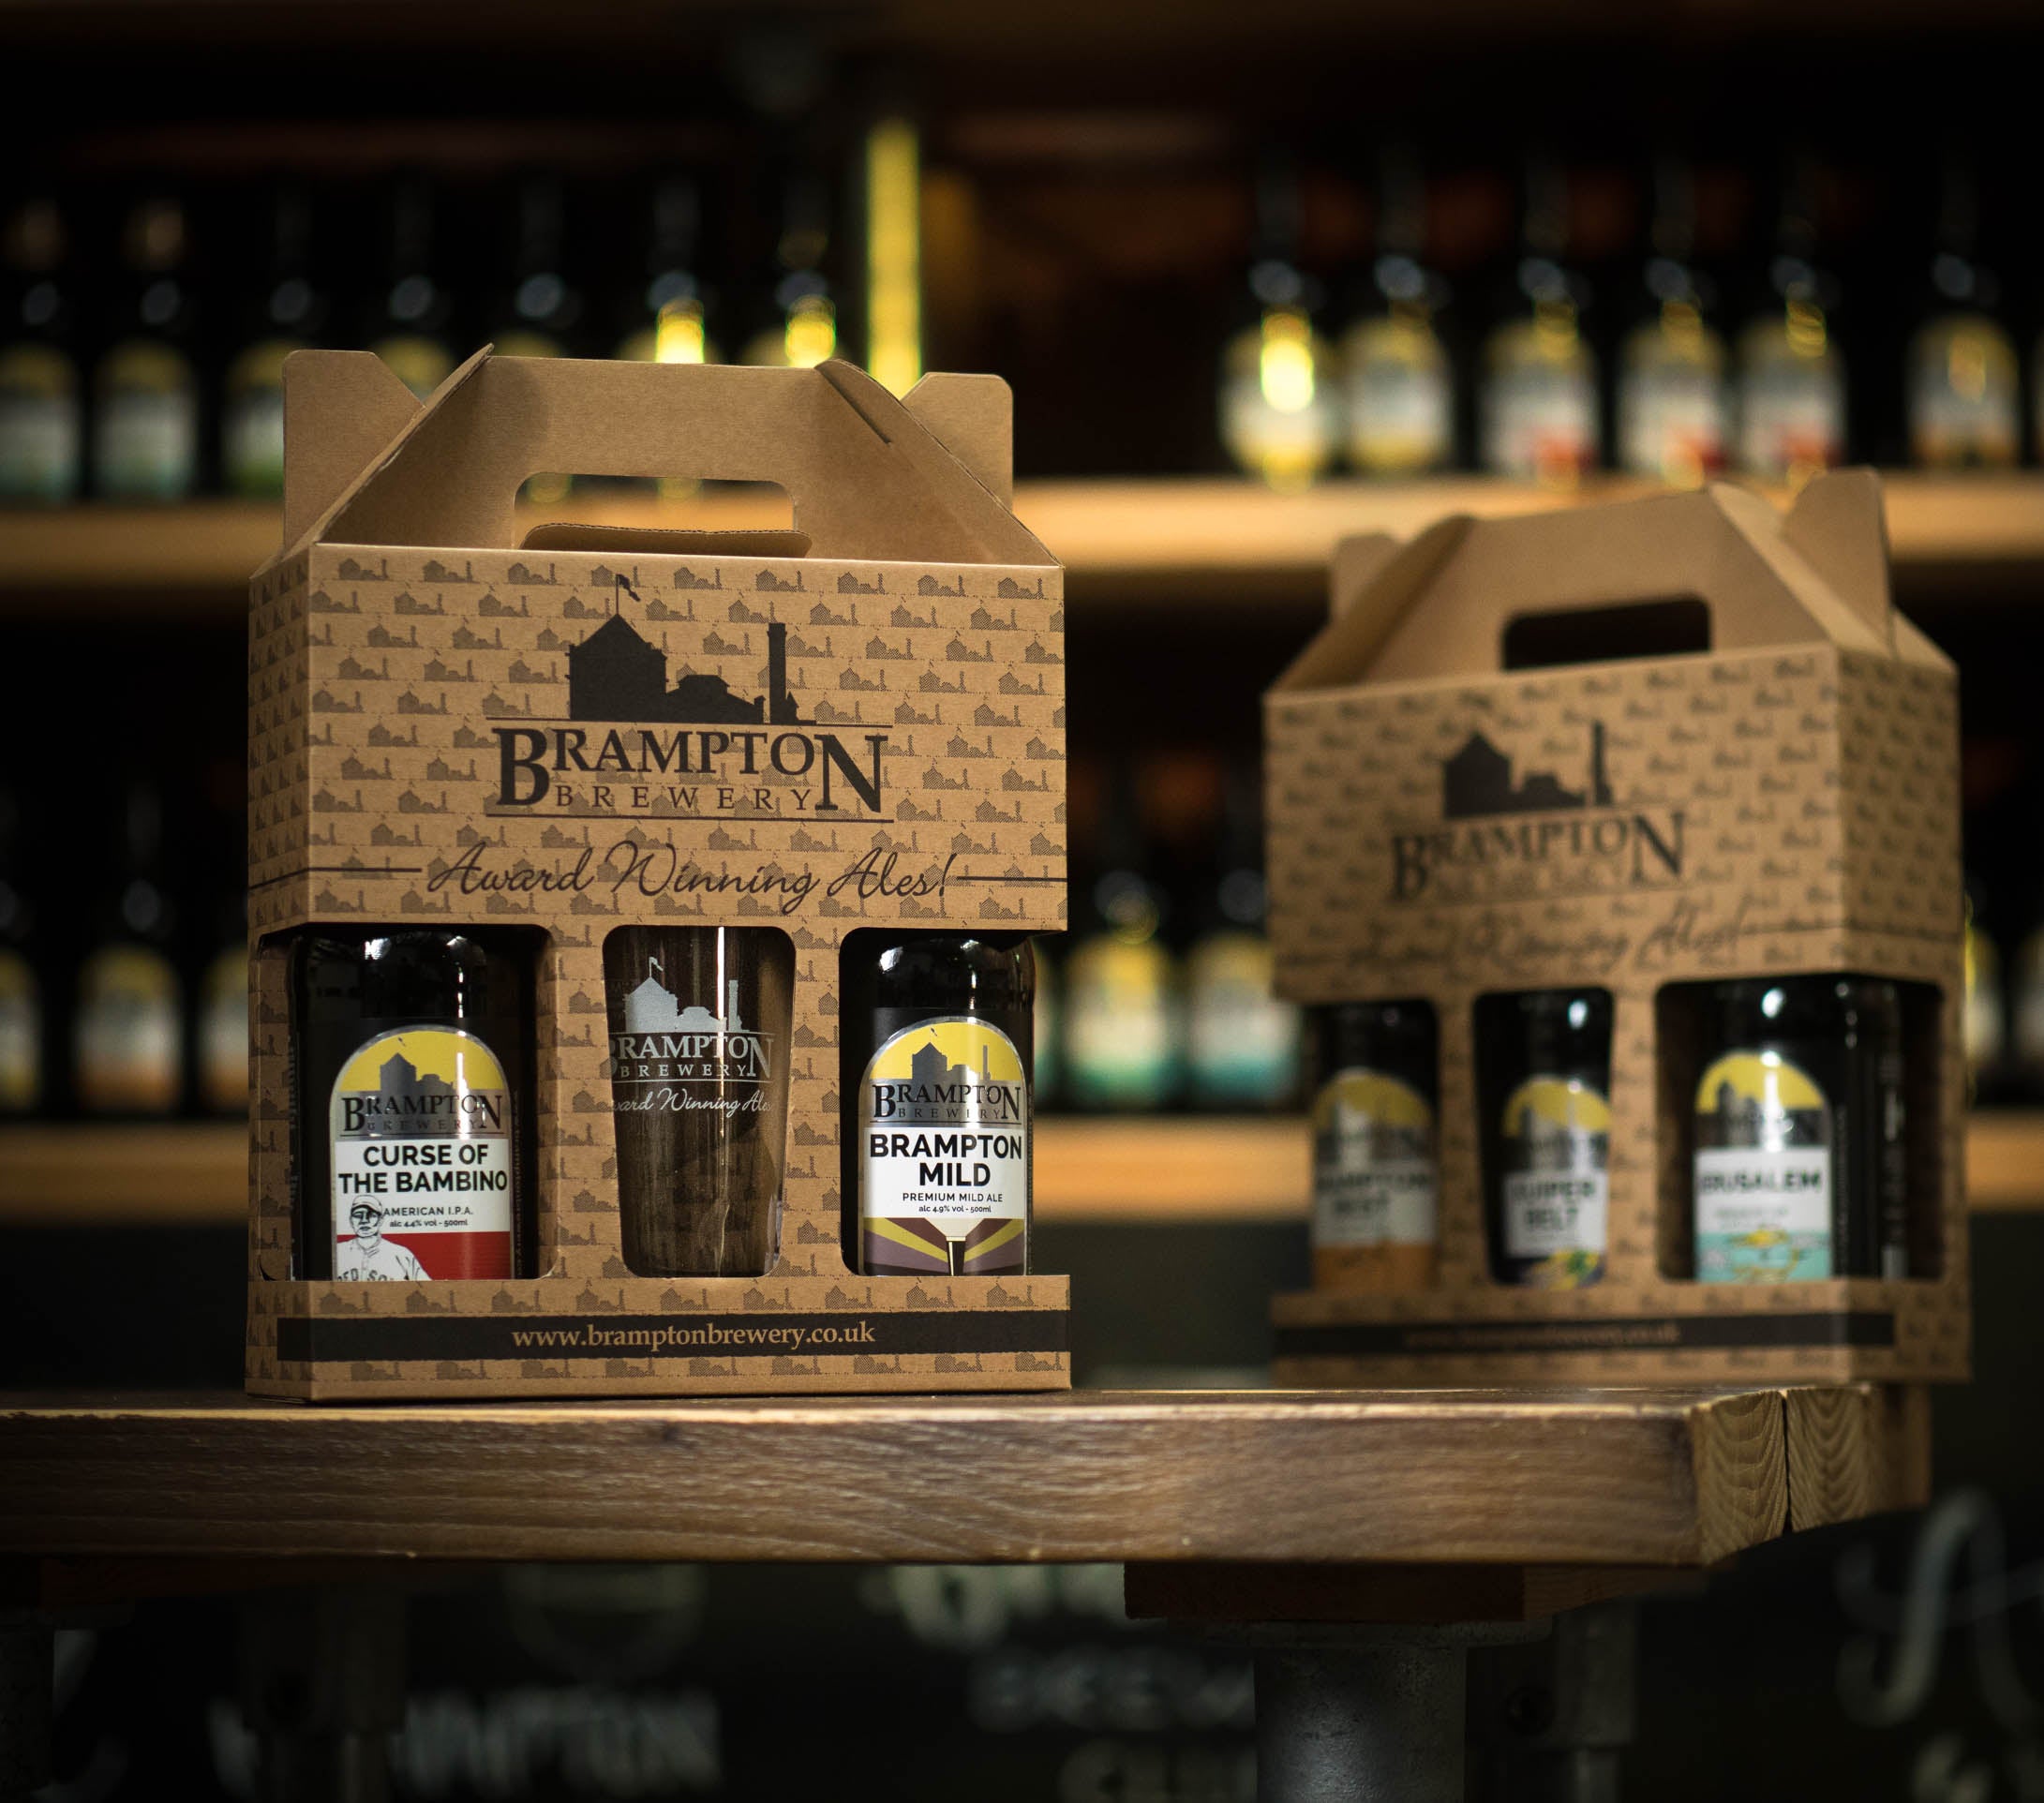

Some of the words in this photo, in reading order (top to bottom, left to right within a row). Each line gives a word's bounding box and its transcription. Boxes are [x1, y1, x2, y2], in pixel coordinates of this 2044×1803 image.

[491, 726, 888, 813] BRAMPTON
[556, 785, 813, 812] BREWERY
[427, 841, 595, 896] Award
[605, 841, 820, 915] Winning
[827, 846, 959, 899] Ales!
[620, 1064, 747, 1078] BREWERY
[342, 1095, 502, 1131] BRAMPTON
[612, 1091, 654, 1111] ward
[657, 1088, 740, 1118] Winning
[872, 1084, 1022, 1121] BRAMPTON
[363, 1145, 452, 1167] CURSE
[458, 1144, 488, 1165] OF
[870, 1134, 1022, 1160] BRAMPTON
[338, 1172, 388, 1194] THE
[395, 1170, 507, 1193] BAMBINO
[919, 1163, 991, 1187] MILD
[903, 1193, 955, 1201] PREMIUM
[959, 1193, 984, 1202] MILD
[987, 1193, 1003, 1202] ALE
[932, 1205, 949, 1214] 4.9%
[952, 1204, 964, 1213] vol
[970, 1205, 992, 1214] 500ml
[384, 1207, 444, 1216] AMERICAN
[449, 1206, 473, 1215] I.P.A.
[366, 1269, 394, 1281] SO
[512, 1320, 875, 1352] www.bramptonbrewery.co.uk
